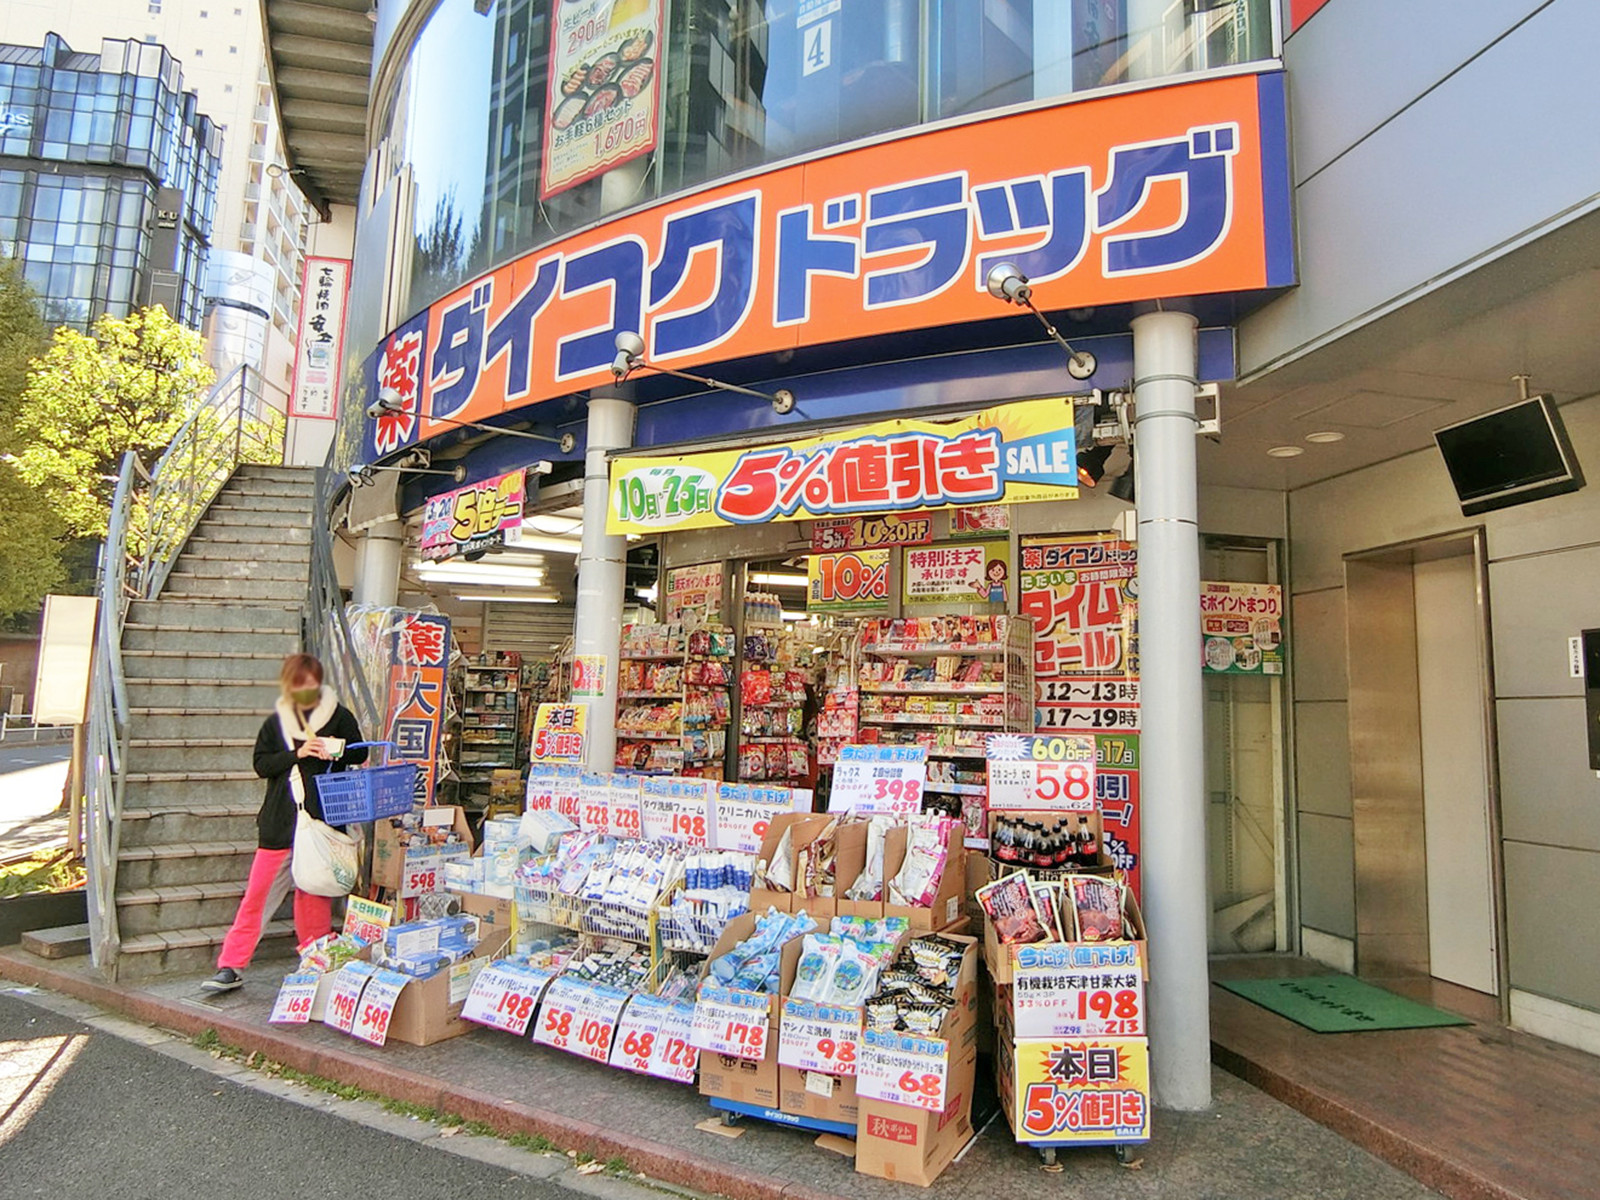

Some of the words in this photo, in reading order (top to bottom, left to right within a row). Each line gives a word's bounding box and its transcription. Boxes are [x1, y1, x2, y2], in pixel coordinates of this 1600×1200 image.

[807, 27, 825, 68] 4
[429, 121, 1240, 426] ダイコクドラッグ
[375, 329, 423, 456] 薬
[1005, 440, 1070, 476] SALE
[719, 433, 999, 520] 5%値引き
[849, 517, 930, 548] 10%OFF
[909, 548, 983, 569] 特別注文
[1022, 547, 1043, 569] 薬
[921, 567, 969, 580] 承ります
[1021, 571, 1077, 591] ただいま
[1022, 582, 1123, 633] タイム
[397, 616, 444, 667] 薬
[1034, 630, 1121, 674] セール
[548, 708, 575, 727] 本日
[534, 729, 583, 758] 5%値引き
[873, 778, 921, 802] 398
[1035, 763, 1090, 800] 58
[532, 795, 552, 811] 498
[585, 804, 609, 826] 228
[890, 802, 918, 813] 437
[1070, 801, 1092, 809] 62
[615, 808, 640, 829] 228
[672, 813, 706, 837] 198
[687, 836, 707, 848] 217
[410, 871, 436, 890] 598
[1017, 946, 1069, 969] 今だけ
[1074, 944, 1137, 967] 値下げ!
[1016, 974, 1138, 991] 有機栽培天津甘栗大袋
[286, 996, 312, 1013] 168
[333, 993, 356, 1020] 798
[496, 991, 534, 1020] 198
[1077, 989, 1139, 1021] 198
[362, 1003, 390, 1033] 598
[505, 1016, 526, 1032] 217
[544, 1007, 573, 1037] 58
[1104, 1019, 1139, 1034] 213
[553, 1036, 568, 1047] 63
[578, 1018, 612, 1050] 108
[622, 1029, 655, 1059] 68
[725, 1021, 764, 1047] 178
[901, 1036, 945, 1056] 値下げ!
[590, 1046, 608, 1060] 118
[661, 1037, 697, 1068] 128
[740, 1045, 763, 1057] 195
[816, 1038, 857, 1062] 98
[633, 1057, 649, 1070] 74
[832, 1061, 857, 1074] 107
[1050, 1048, 1117, 1080] 本日
[898, 1070, 942, 1096] 68
[916, 1095, 941, 1108] 73
[1025, 1083, 1142, 1133] 5%値引き
[872, 1118, 889, 1138] 秋
[1116, 1127, 1141, 1135] SALE
